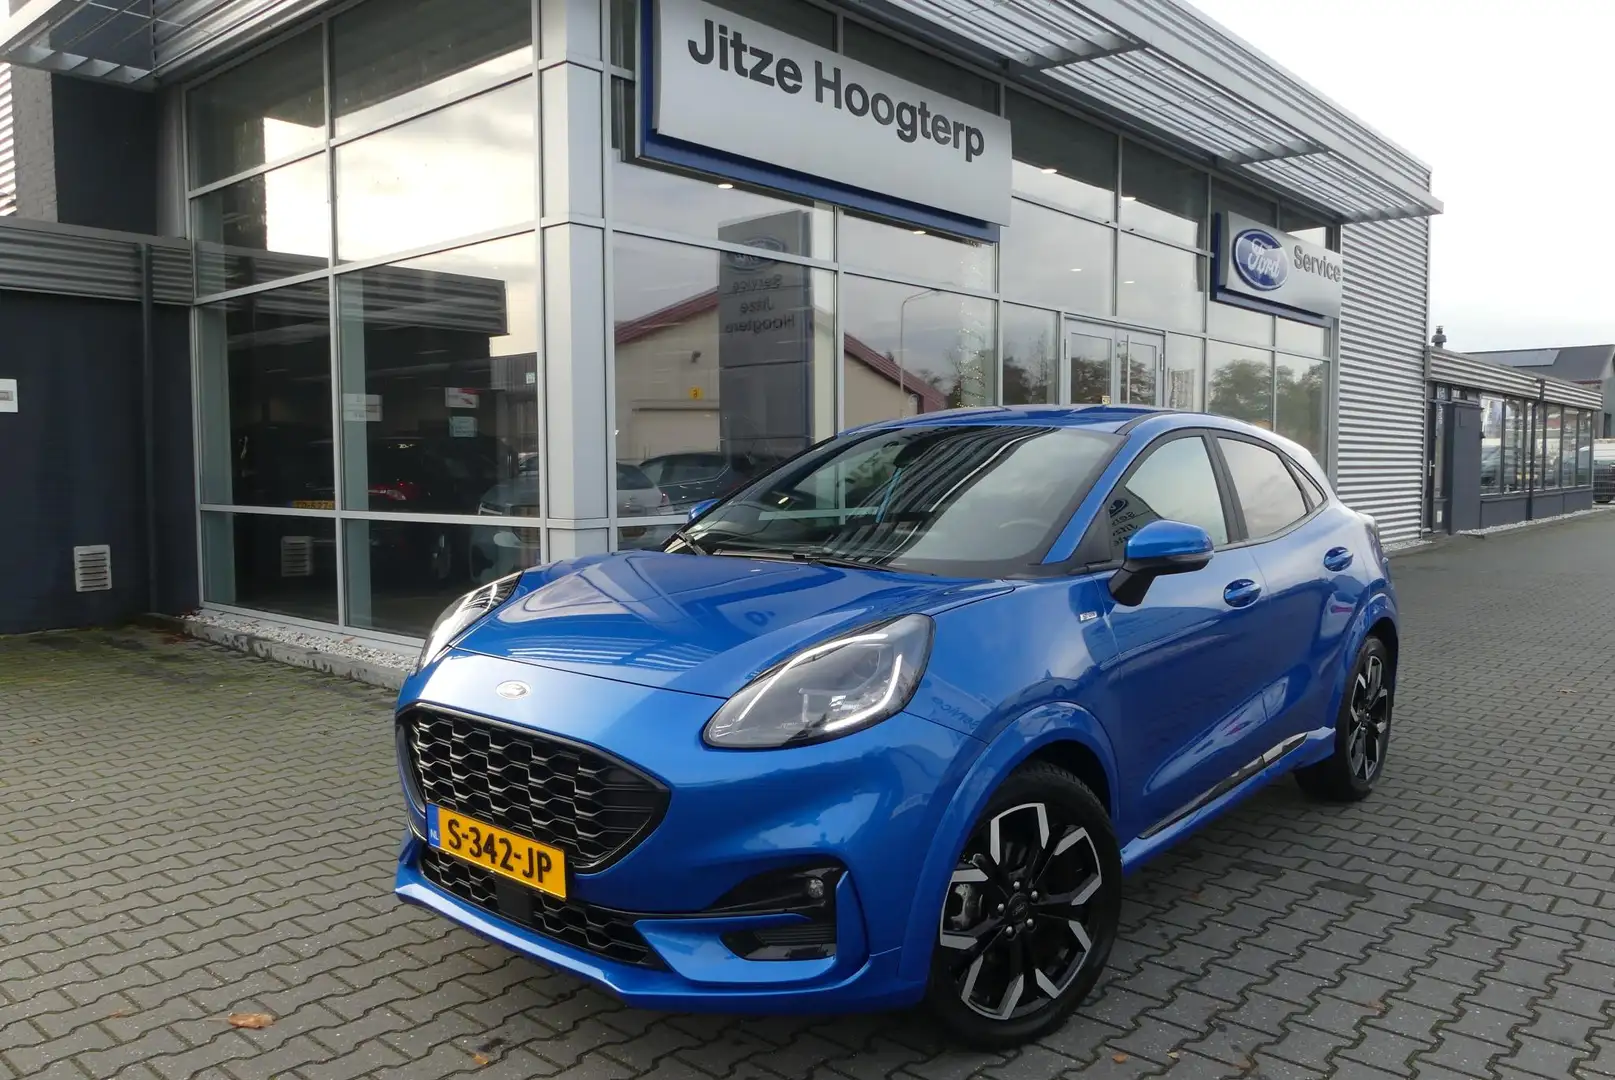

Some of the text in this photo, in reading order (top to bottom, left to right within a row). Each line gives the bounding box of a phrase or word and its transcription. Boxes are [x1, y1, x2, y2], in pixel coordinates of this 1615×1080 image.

[687, 18, 985, 163] Jitze Hoogterp
[1293, 244, 1341, 283] Service
[430, 827, 440, 838] NL
[447, 818, 553, 884] S-342-JP
